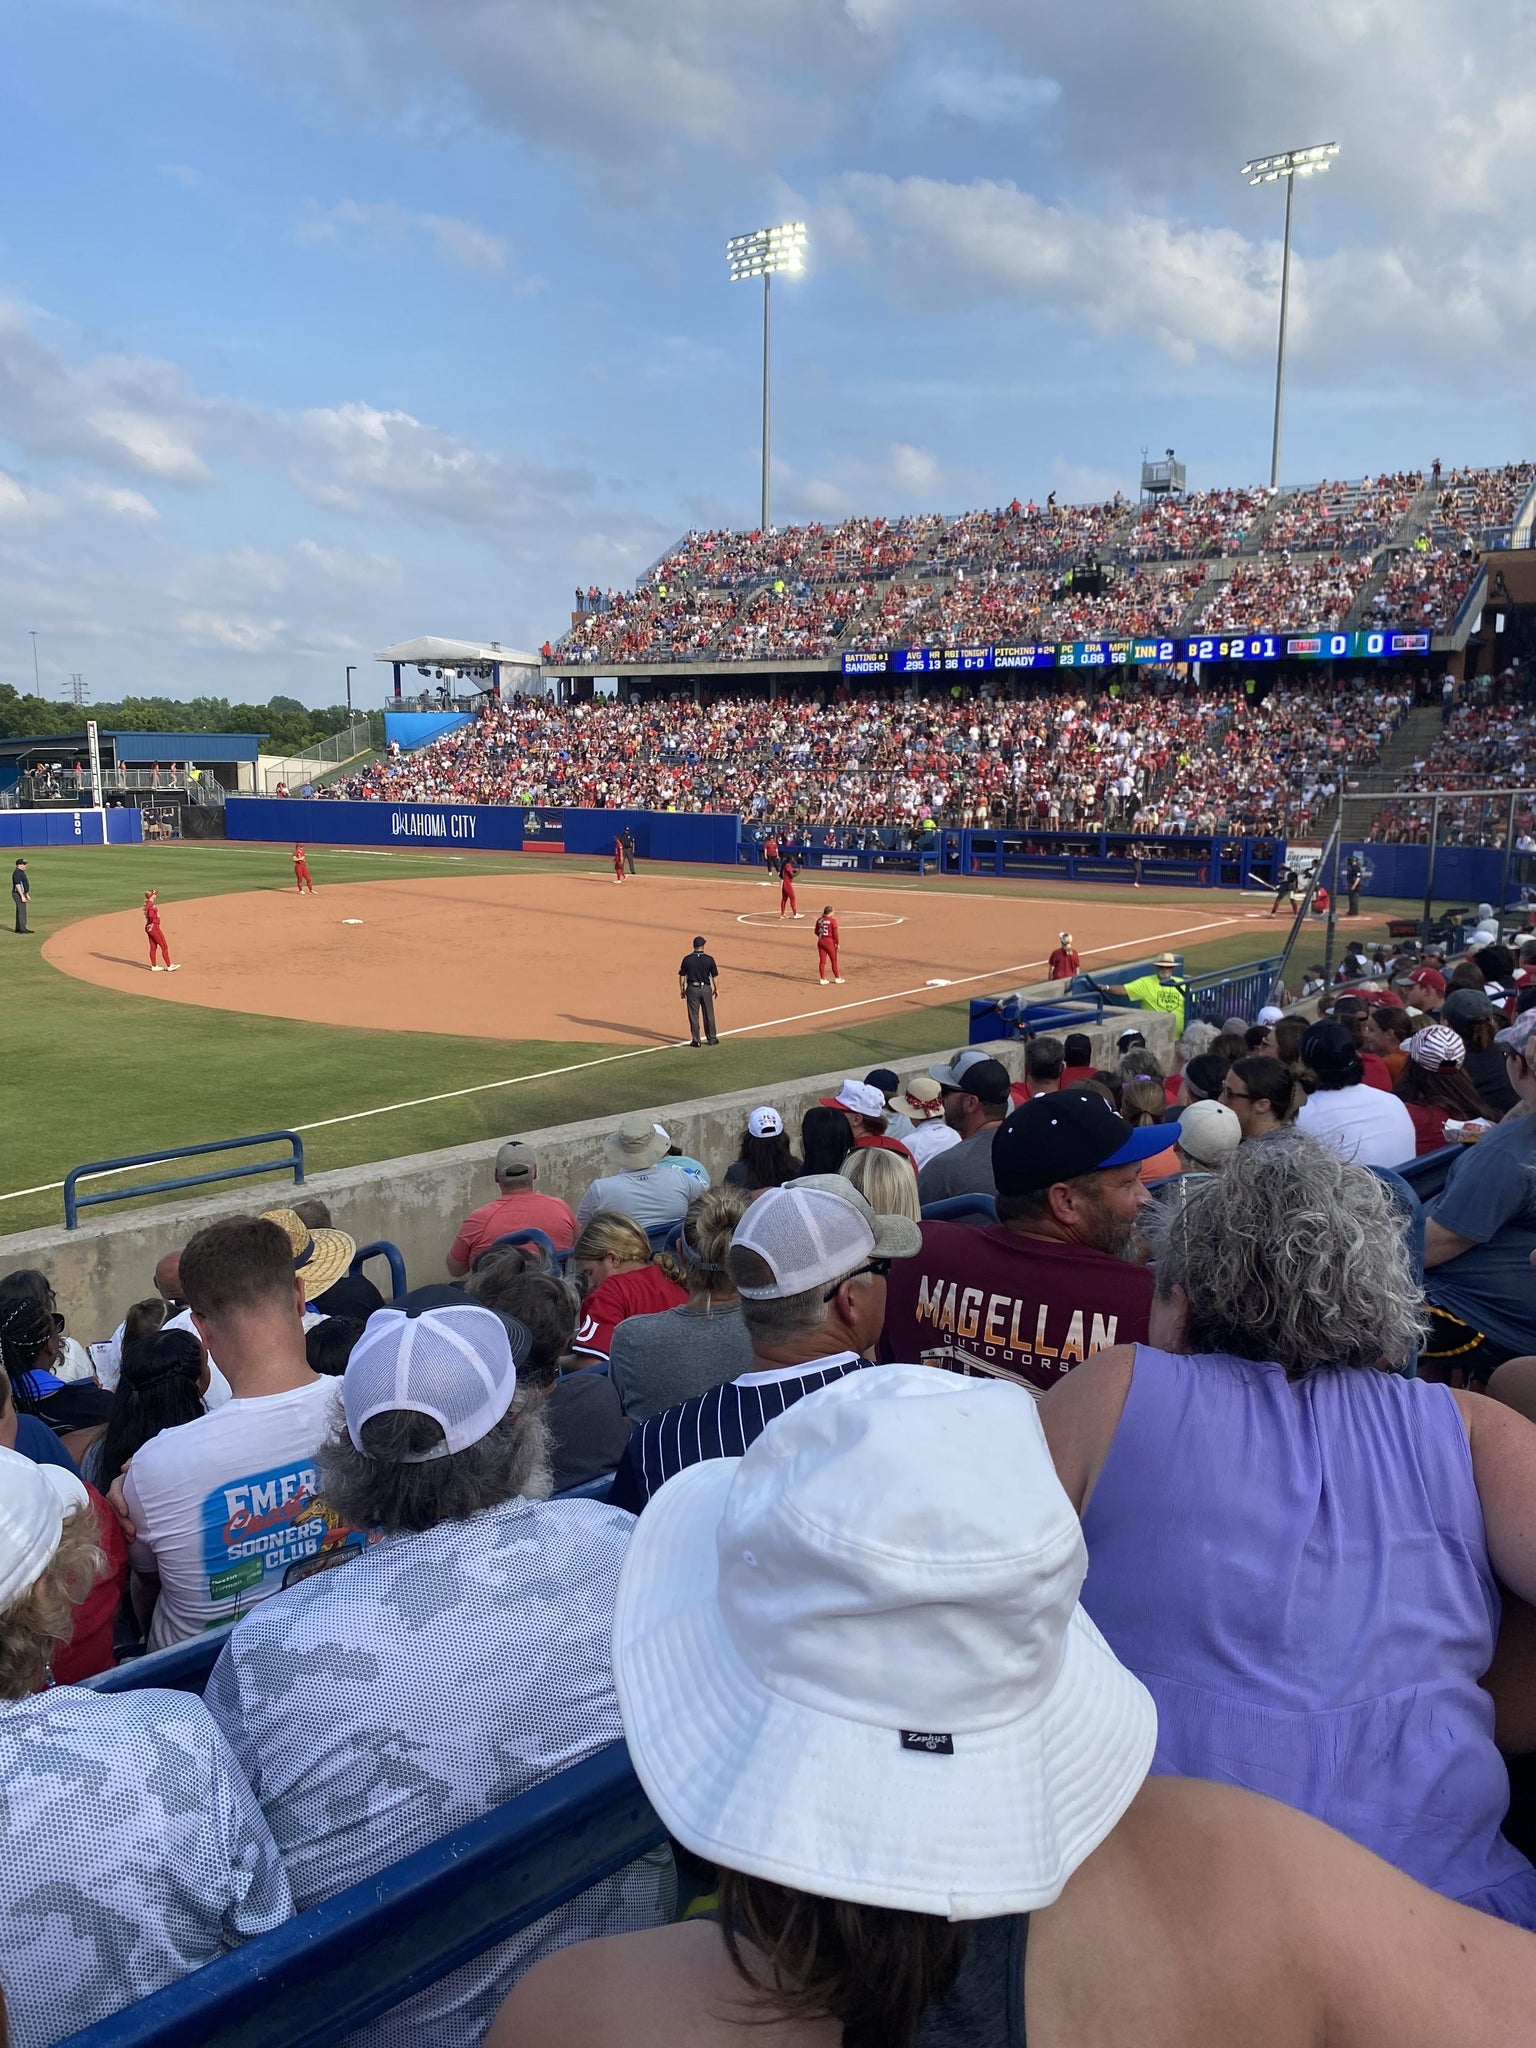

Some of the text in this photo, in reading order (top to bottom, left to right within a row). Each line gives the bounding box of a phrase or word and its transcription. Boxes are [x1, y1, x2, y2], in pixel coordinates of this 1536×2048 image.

[1061, 643, 1129, 653] PC ERA MPH
[1188, 644, 1197, 656] B
[1199, 641, 1213, 658] 2
[1219, 643, 1229, 655] S
[1230, 640, 1244, 657] 2
[1263, 639, 1275, 656] 1
[1330, 636, 1346, 654] 0
[1367, 635, 1383, 653] 0
[906, 649, 988, 660] AVG HR RBI TONIGHT
[994, 648, 1035, 656] PITCHING
[1134, 642, 1173, 660] INN 2
[845, 654, 877, 662] BATTING
[903, 658, 984, 670] .295 13 36 0-0
[994, 657, 1035, 667] CANADY
[1060, 653, 1126, 665] 23 0.86 56
[845, 662, 886, 672] SANDERS
[391, 808, 476, 838] OKLAHOMA CITY
[821, 855, 858, 867] ESPN
[915, 1275, 1118, 1362] MAGELLAN
[943, 1334, 1069, 1372] OUTDOORS
[227, 1518, 322, 1561] SOONERS
[265, 1538, 317, 1569] CLUB
[908, 1733, 948, 1744] Zephyr
